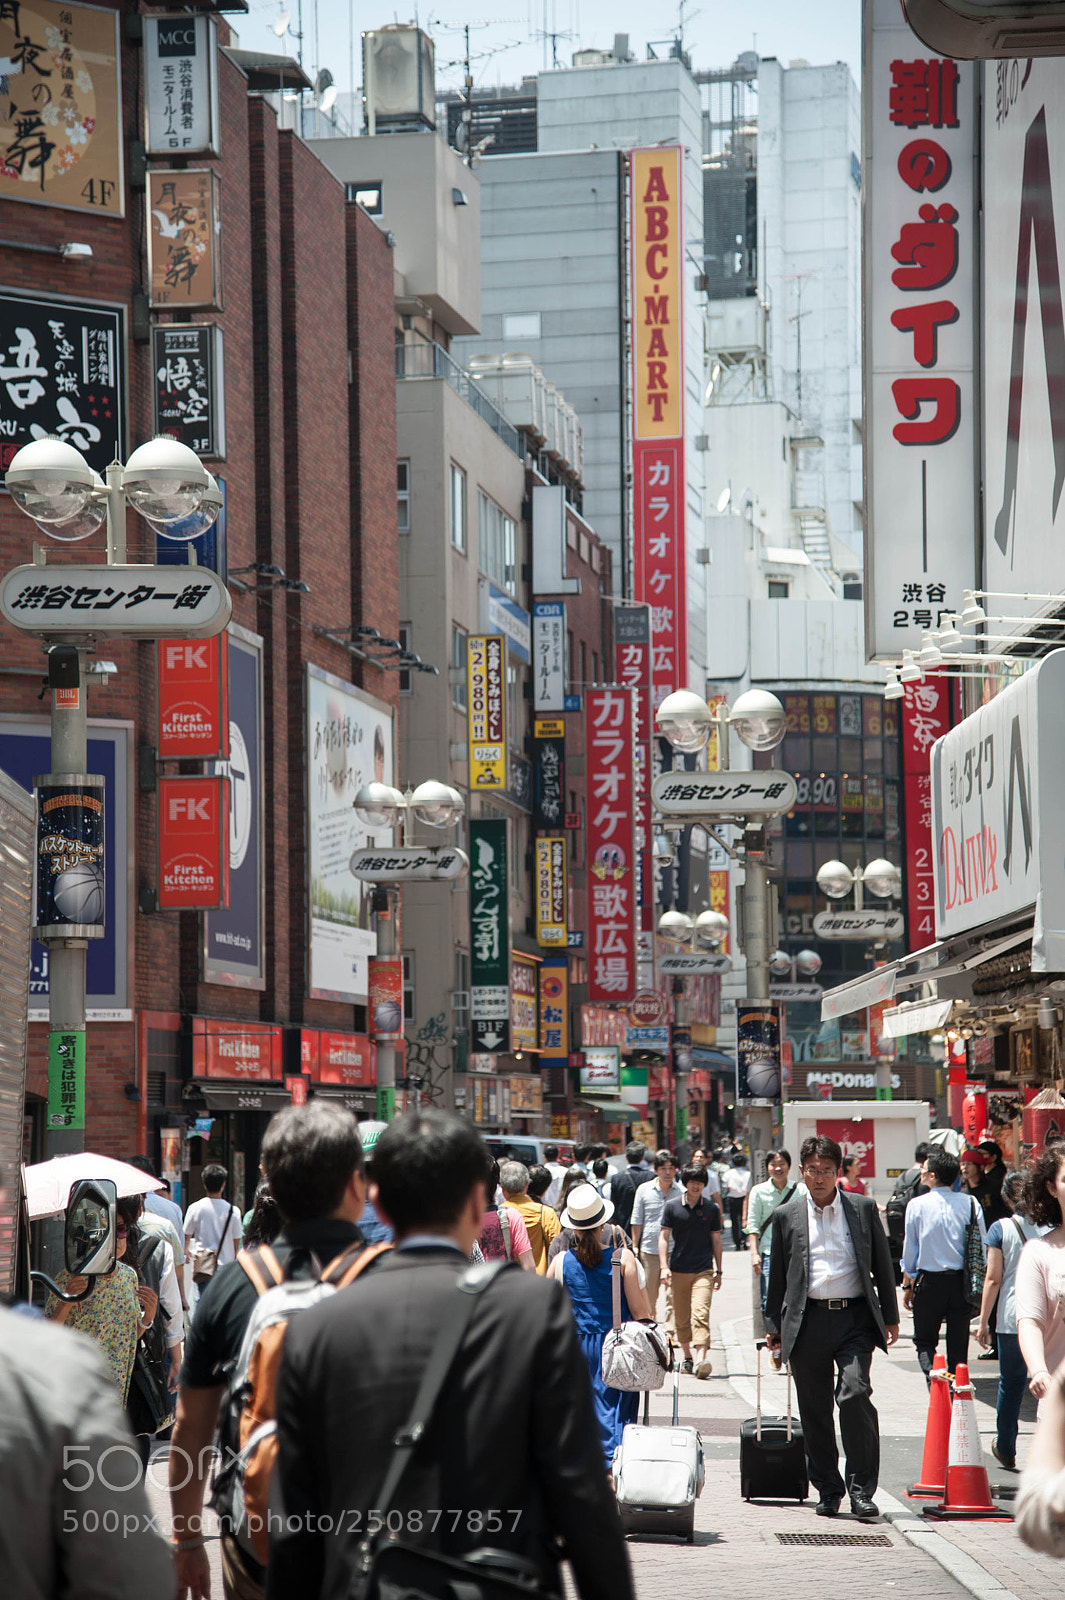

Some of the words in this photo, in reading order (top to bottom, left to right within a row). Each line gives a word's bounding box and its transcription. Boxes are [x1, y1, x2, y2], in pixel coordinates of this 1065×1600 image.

[159, 30, 195, 46] MCC
[59, 10, 75, 100] 個室居酒屋
[162, 65, 177, 135] モニタールーム
[179, 59, 194, 129] 渋谷消費者
[169, 138, 191, 148] 5F
[81, 178, 115, 206] 4F
[890, 59, 960, 445] 靴のダイワ
[643, 167, 669, 422] ABC-MART
[48, 319, 80, 398] 天空の城
[88, 329, 98, 384] ダイニング
[192, 439, 209, 449] 3F
[12, 585, 212, 610] 渋谷センター街
[902, 583, 946, 604] 渋谷
[166, 646, 208, 669] FK
[59, 688, 75, 699] JBL
[487, 641, 501, 741] 全身もみほぐし
[172, 713, 202, 722] First
[163, 723, 212, 733] Kitchen
[593, 691, 628, 839] カラオケ
[660, 783, 788, 801] 渋谷センター街
[169, 798, 210, 820] FK
[355, 856, 455, 871] 渋谷センター街
[915, 848, 928, 868] 2
[164, 875, 214, 885] Kitchen
[174, 865, 204, 875] First
[917, 882, 930, 901] 3
[820, 918, 899, 930] 渋谷センター街
[918, 915, 933, 933] 4
[568, 934, 582, 945] 2F
[593, 884, 629, 992] 歌広場
[662, 959, 726, 968] 渋谷センター街
[543, 1005, 563, 1048] 松屋
